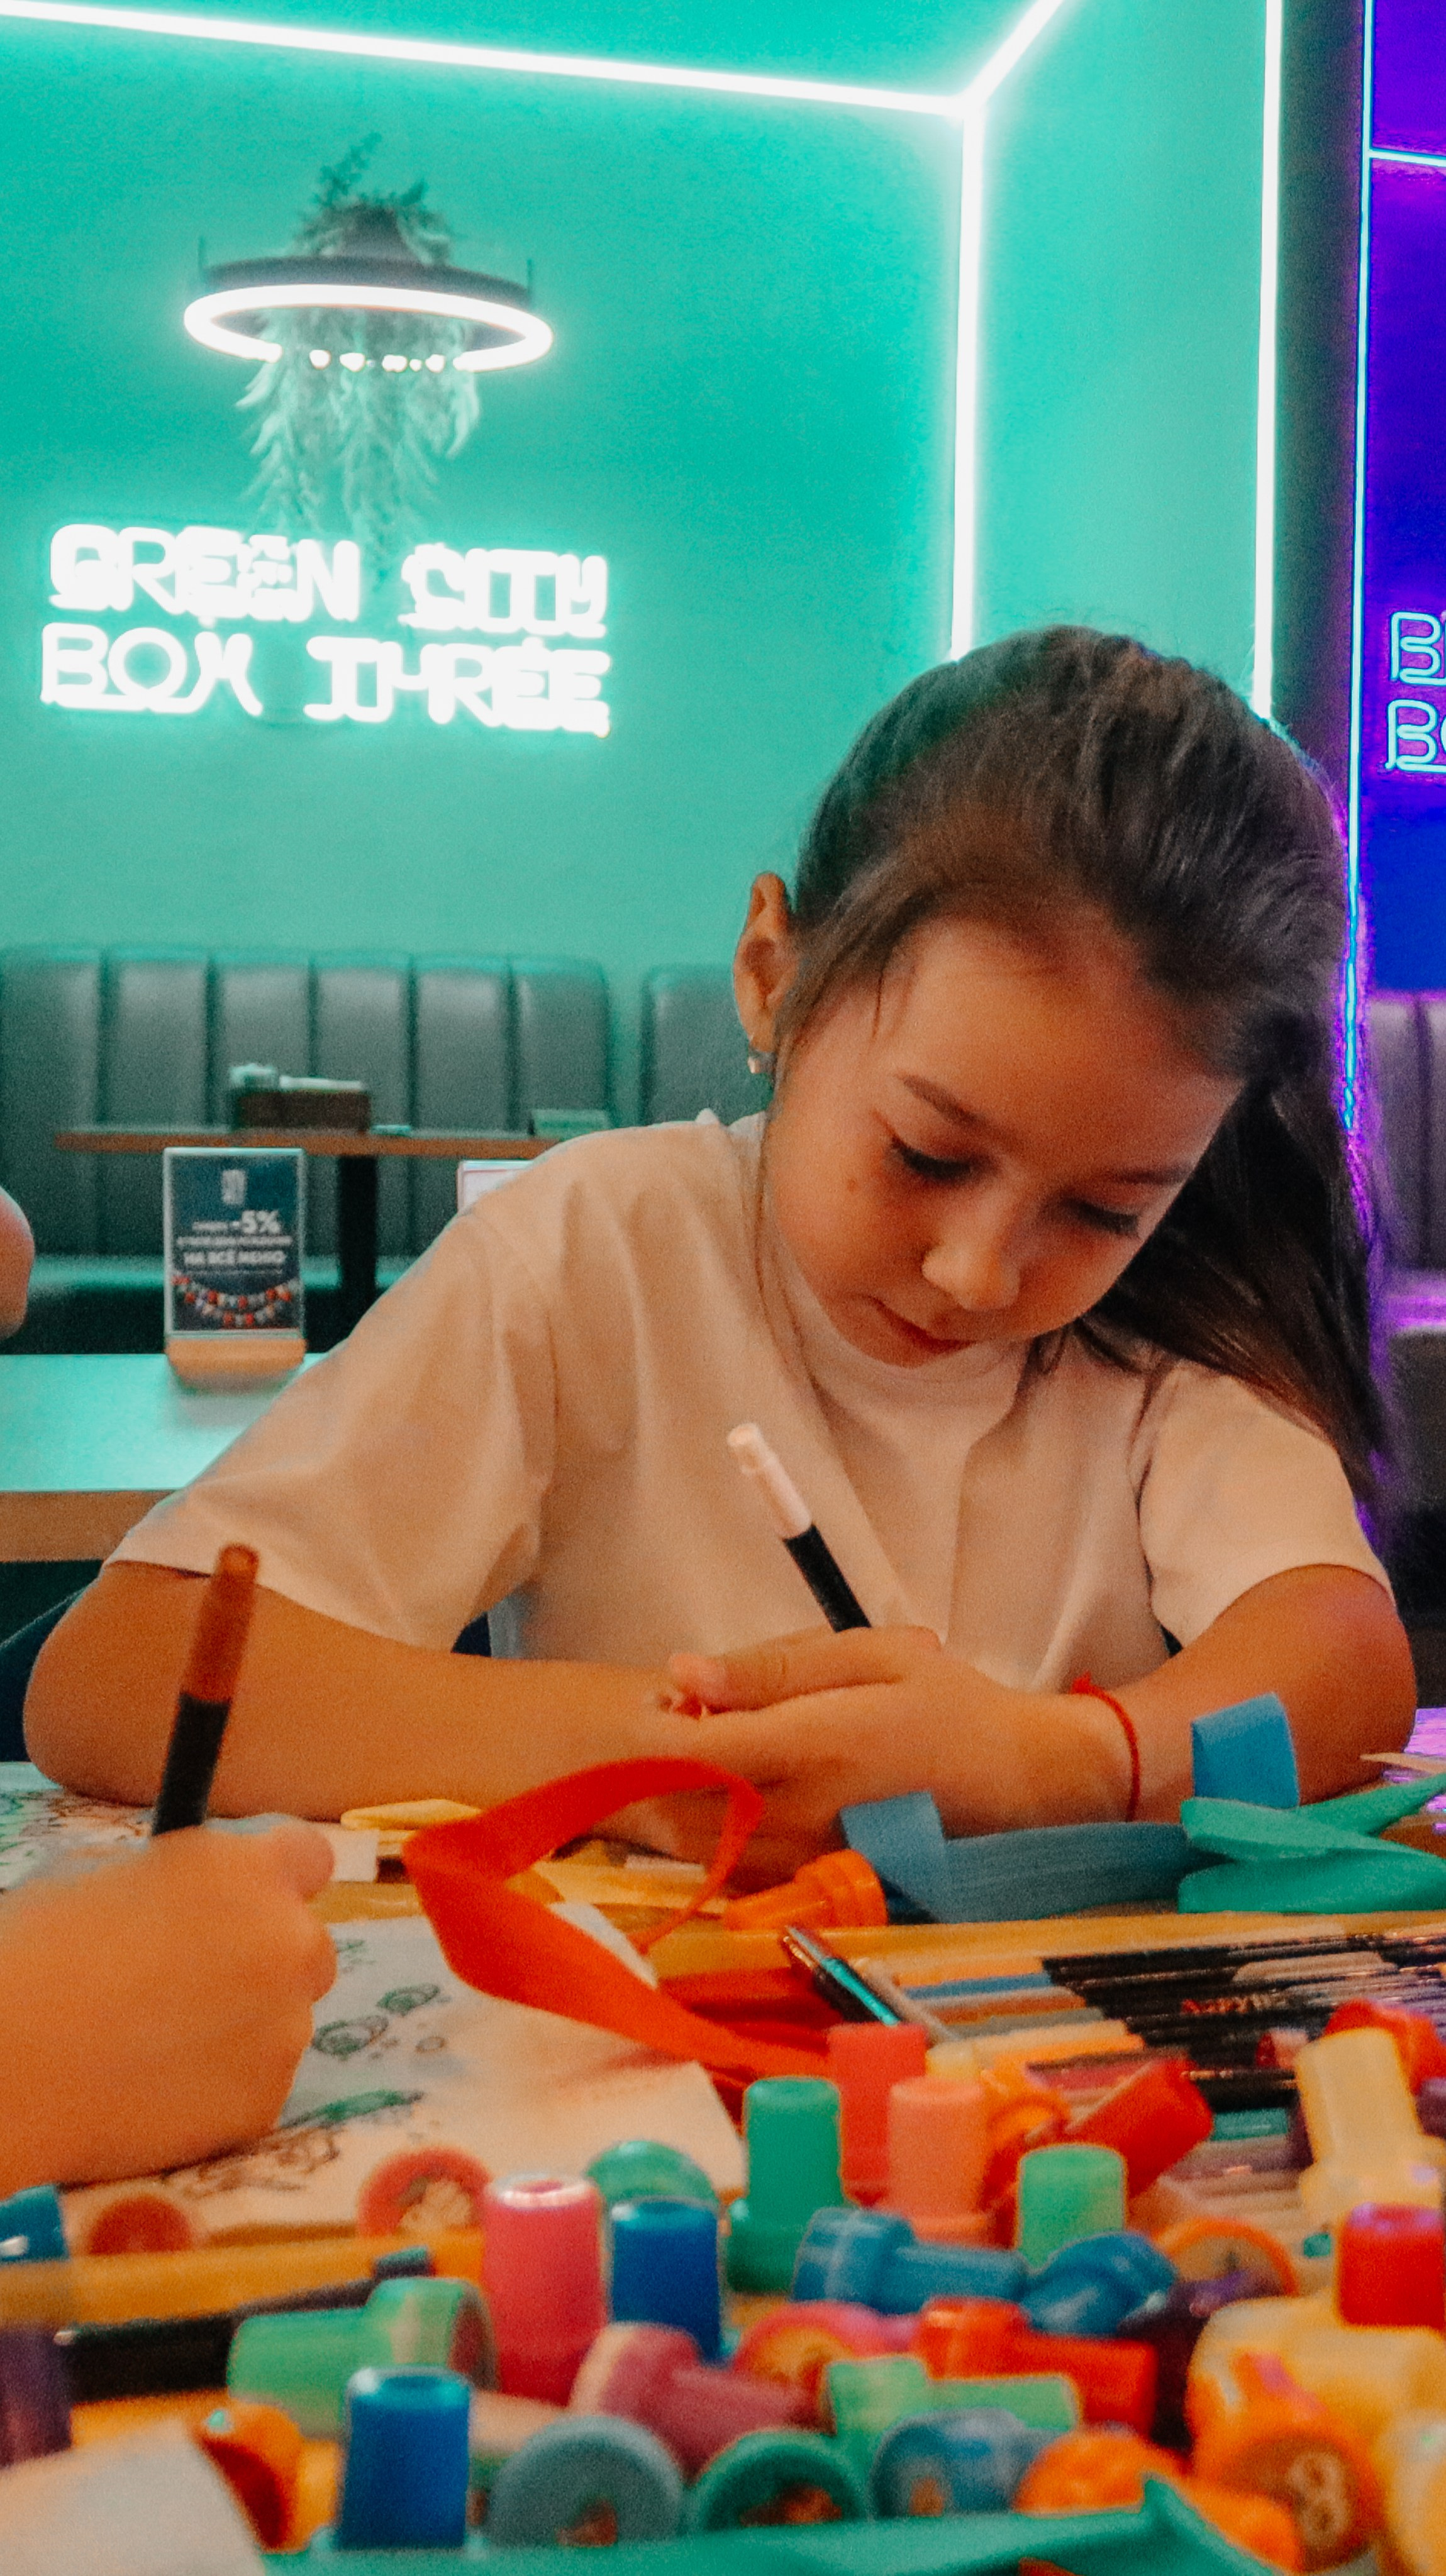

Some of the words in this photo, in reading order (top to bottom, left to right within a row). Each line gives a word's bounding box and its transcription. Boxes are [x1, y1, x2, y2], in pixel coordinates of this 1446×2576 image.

[50, 524, 360, 623] GREEN
[41, 623, 263, 716] BOX
[304, 635, 611, 738] THREE
[1390, 611, 1446, 686] B
[1385, 699, 1446, 773] B
